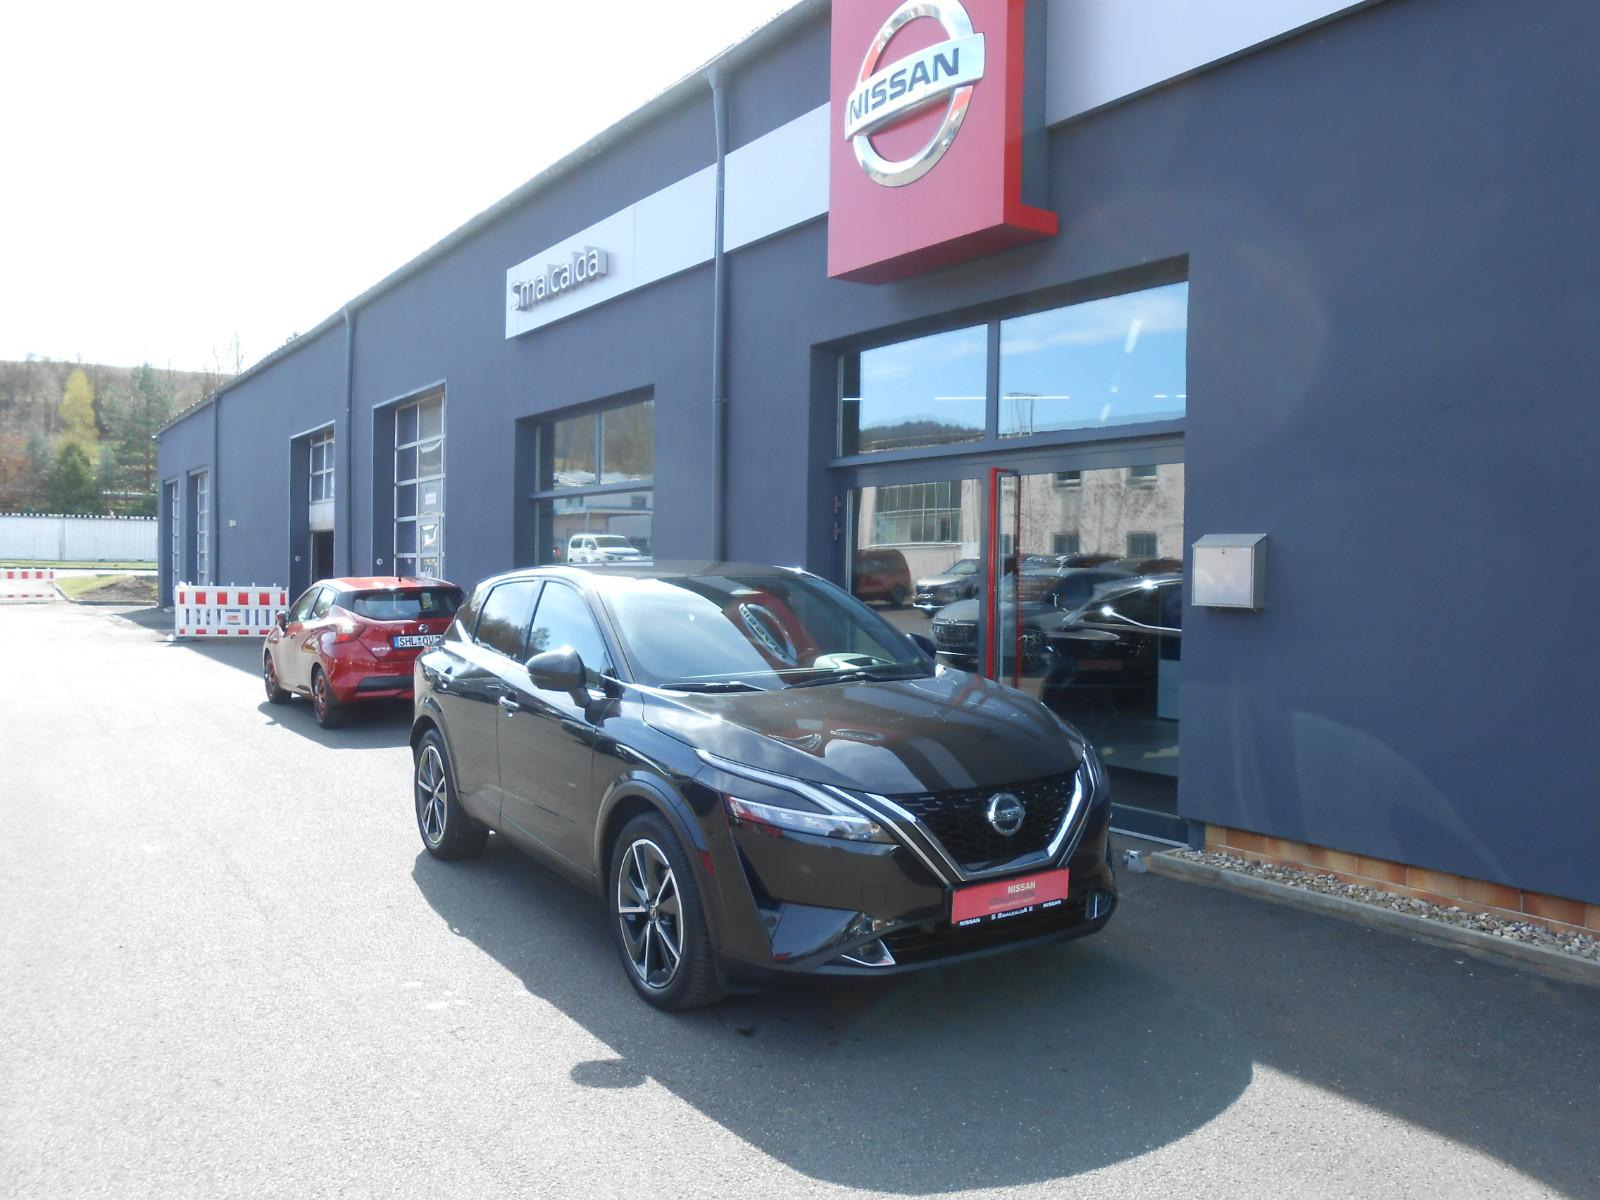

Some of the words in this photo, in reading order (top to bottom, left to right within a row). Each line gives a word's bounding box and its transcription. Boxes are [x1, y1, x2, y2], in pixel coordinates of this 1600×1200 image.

[849, 47, 960, 125] NISSAN
[400, 637, 417, 647] SHL
[1007, 881, 1036, 894] NISSAN
[959, 918, 980, 927] NISSAN
[1043, 900, 1061, 909] NISSAN
